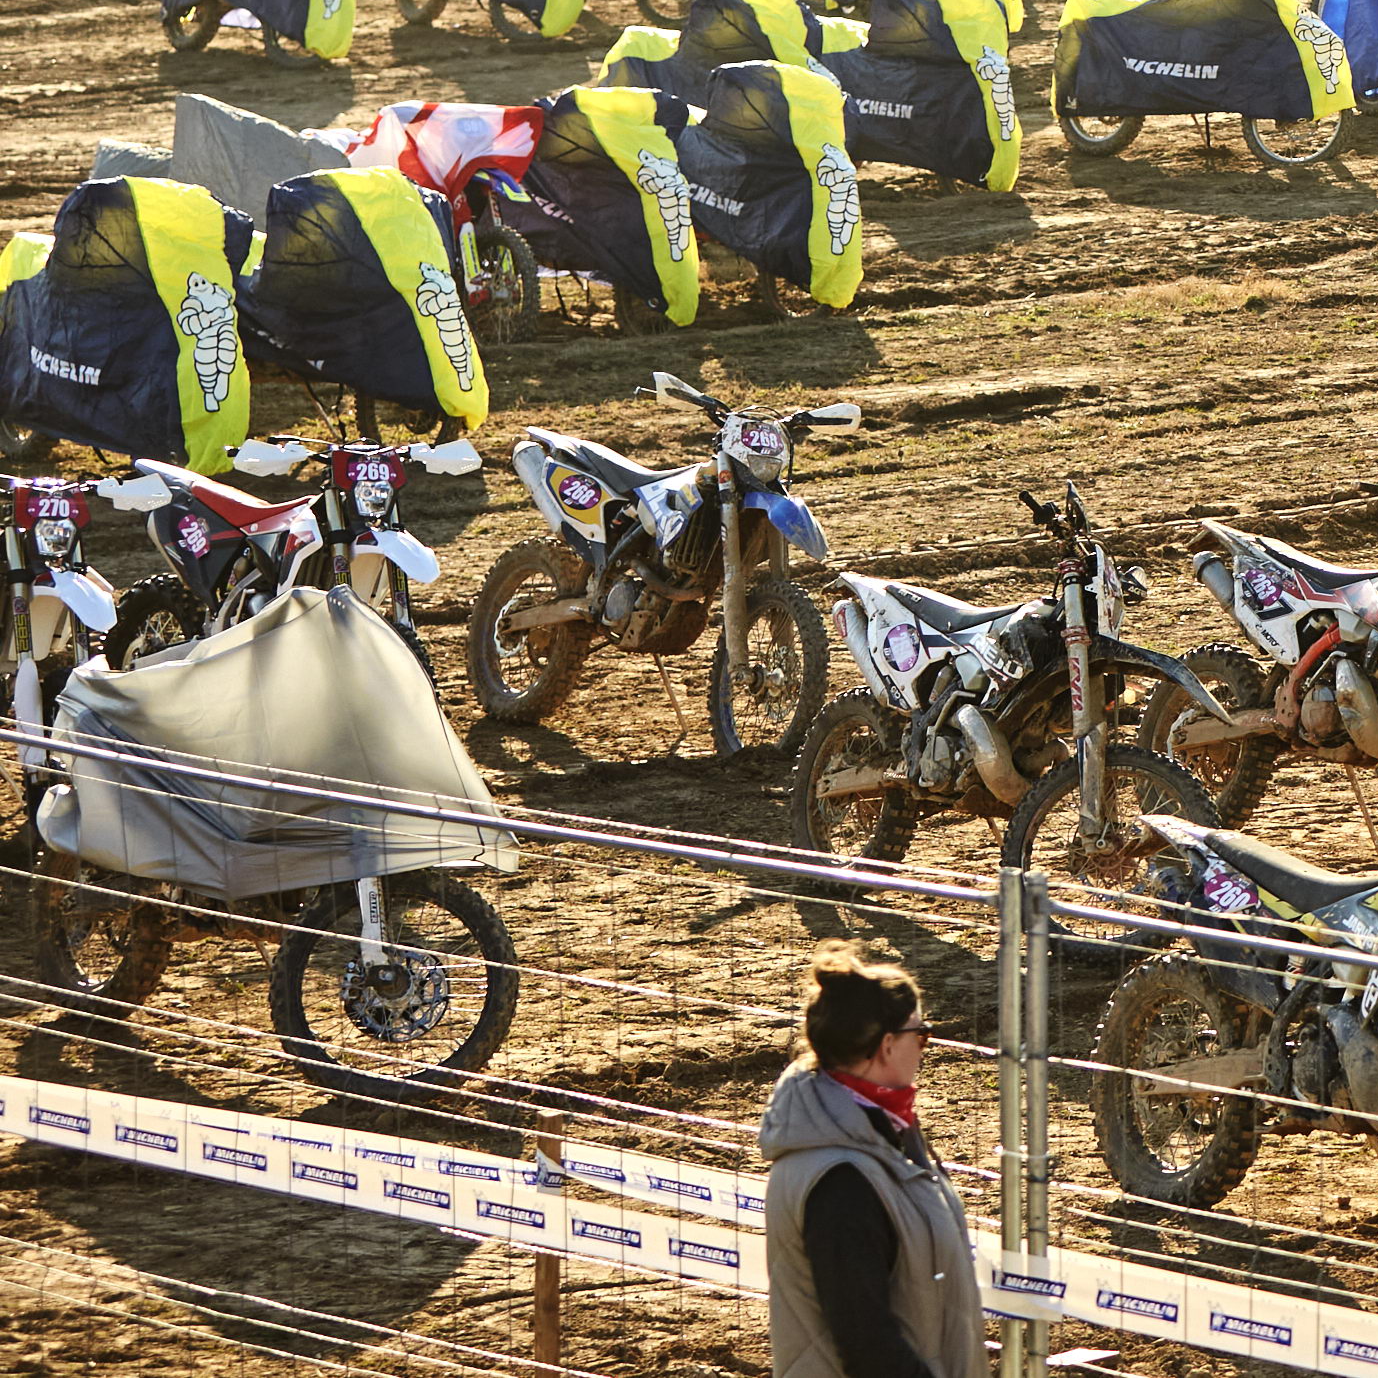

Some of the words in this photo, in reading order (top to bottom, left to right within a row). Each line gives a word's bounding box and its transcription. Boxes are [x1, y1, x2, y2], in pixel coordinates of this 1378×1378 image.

[749, 430, 778, 448] 268
[356, 462, 390, 482] 269
[563, 480, 596, 505] 268
[38, 498, 70, 518] 270
[181, 521, 207, 554] 269
[1251, 573, 1277, 602] 263
[1209, 880, 1251, 910] 260
[1005, 1276, 1063, 1296] MICHELIN
